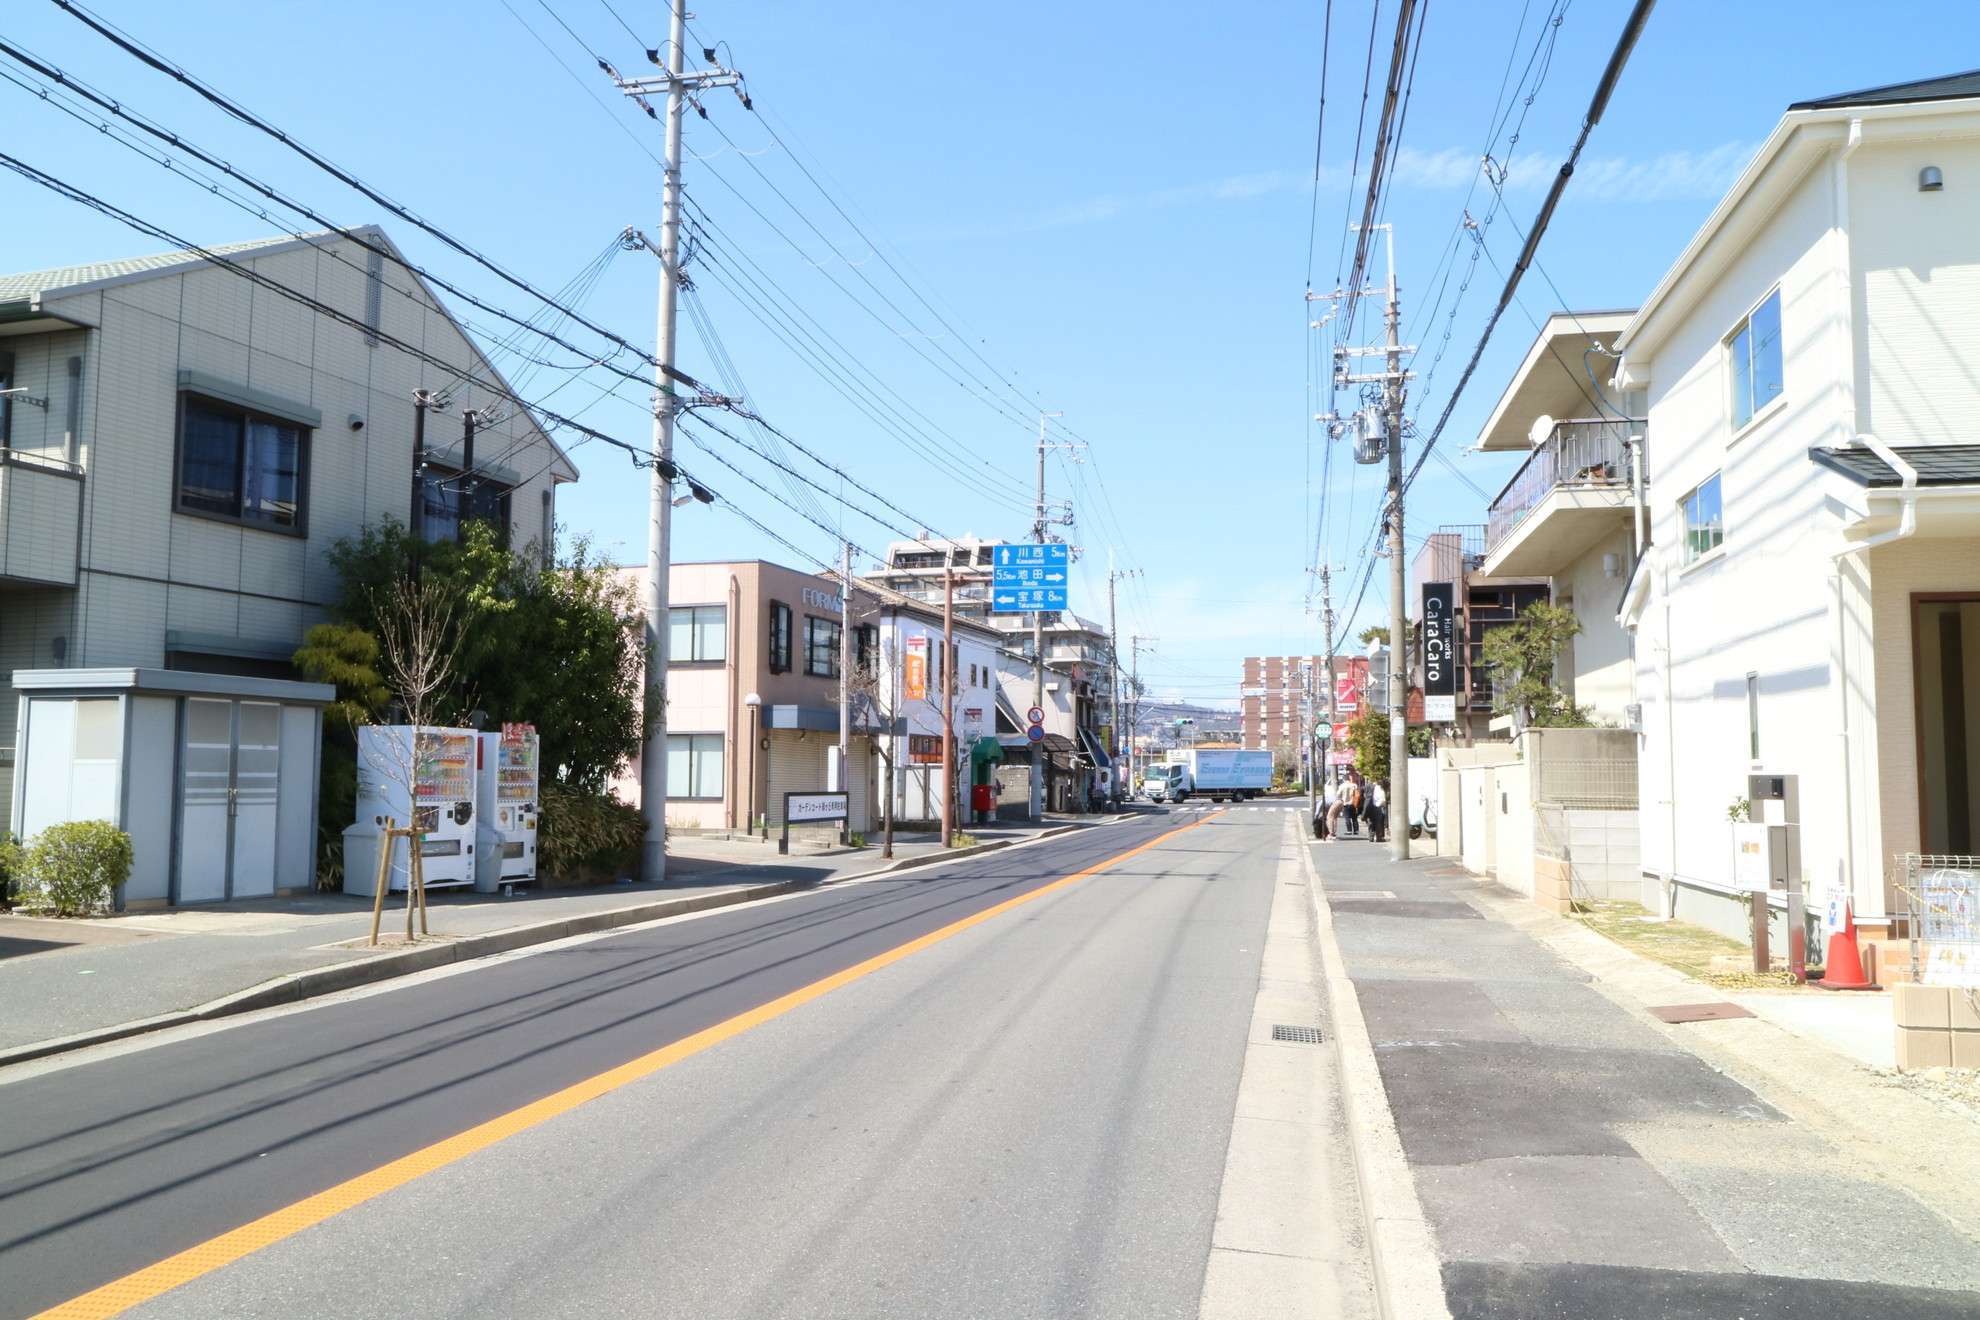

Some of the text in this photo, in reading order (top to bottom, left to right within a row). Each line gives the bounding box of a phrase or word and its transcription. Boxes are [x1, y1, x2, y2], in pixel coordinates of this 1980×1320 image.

[1018, 547, 1044, 558] 川西
[1017, 569, 1043, 580] 池田
[1018, 591, 1044, 601] 宝塚
[1426, 597, 1443, 681] CaraCaro
[1444, 618, 1453, 660] Hair works
